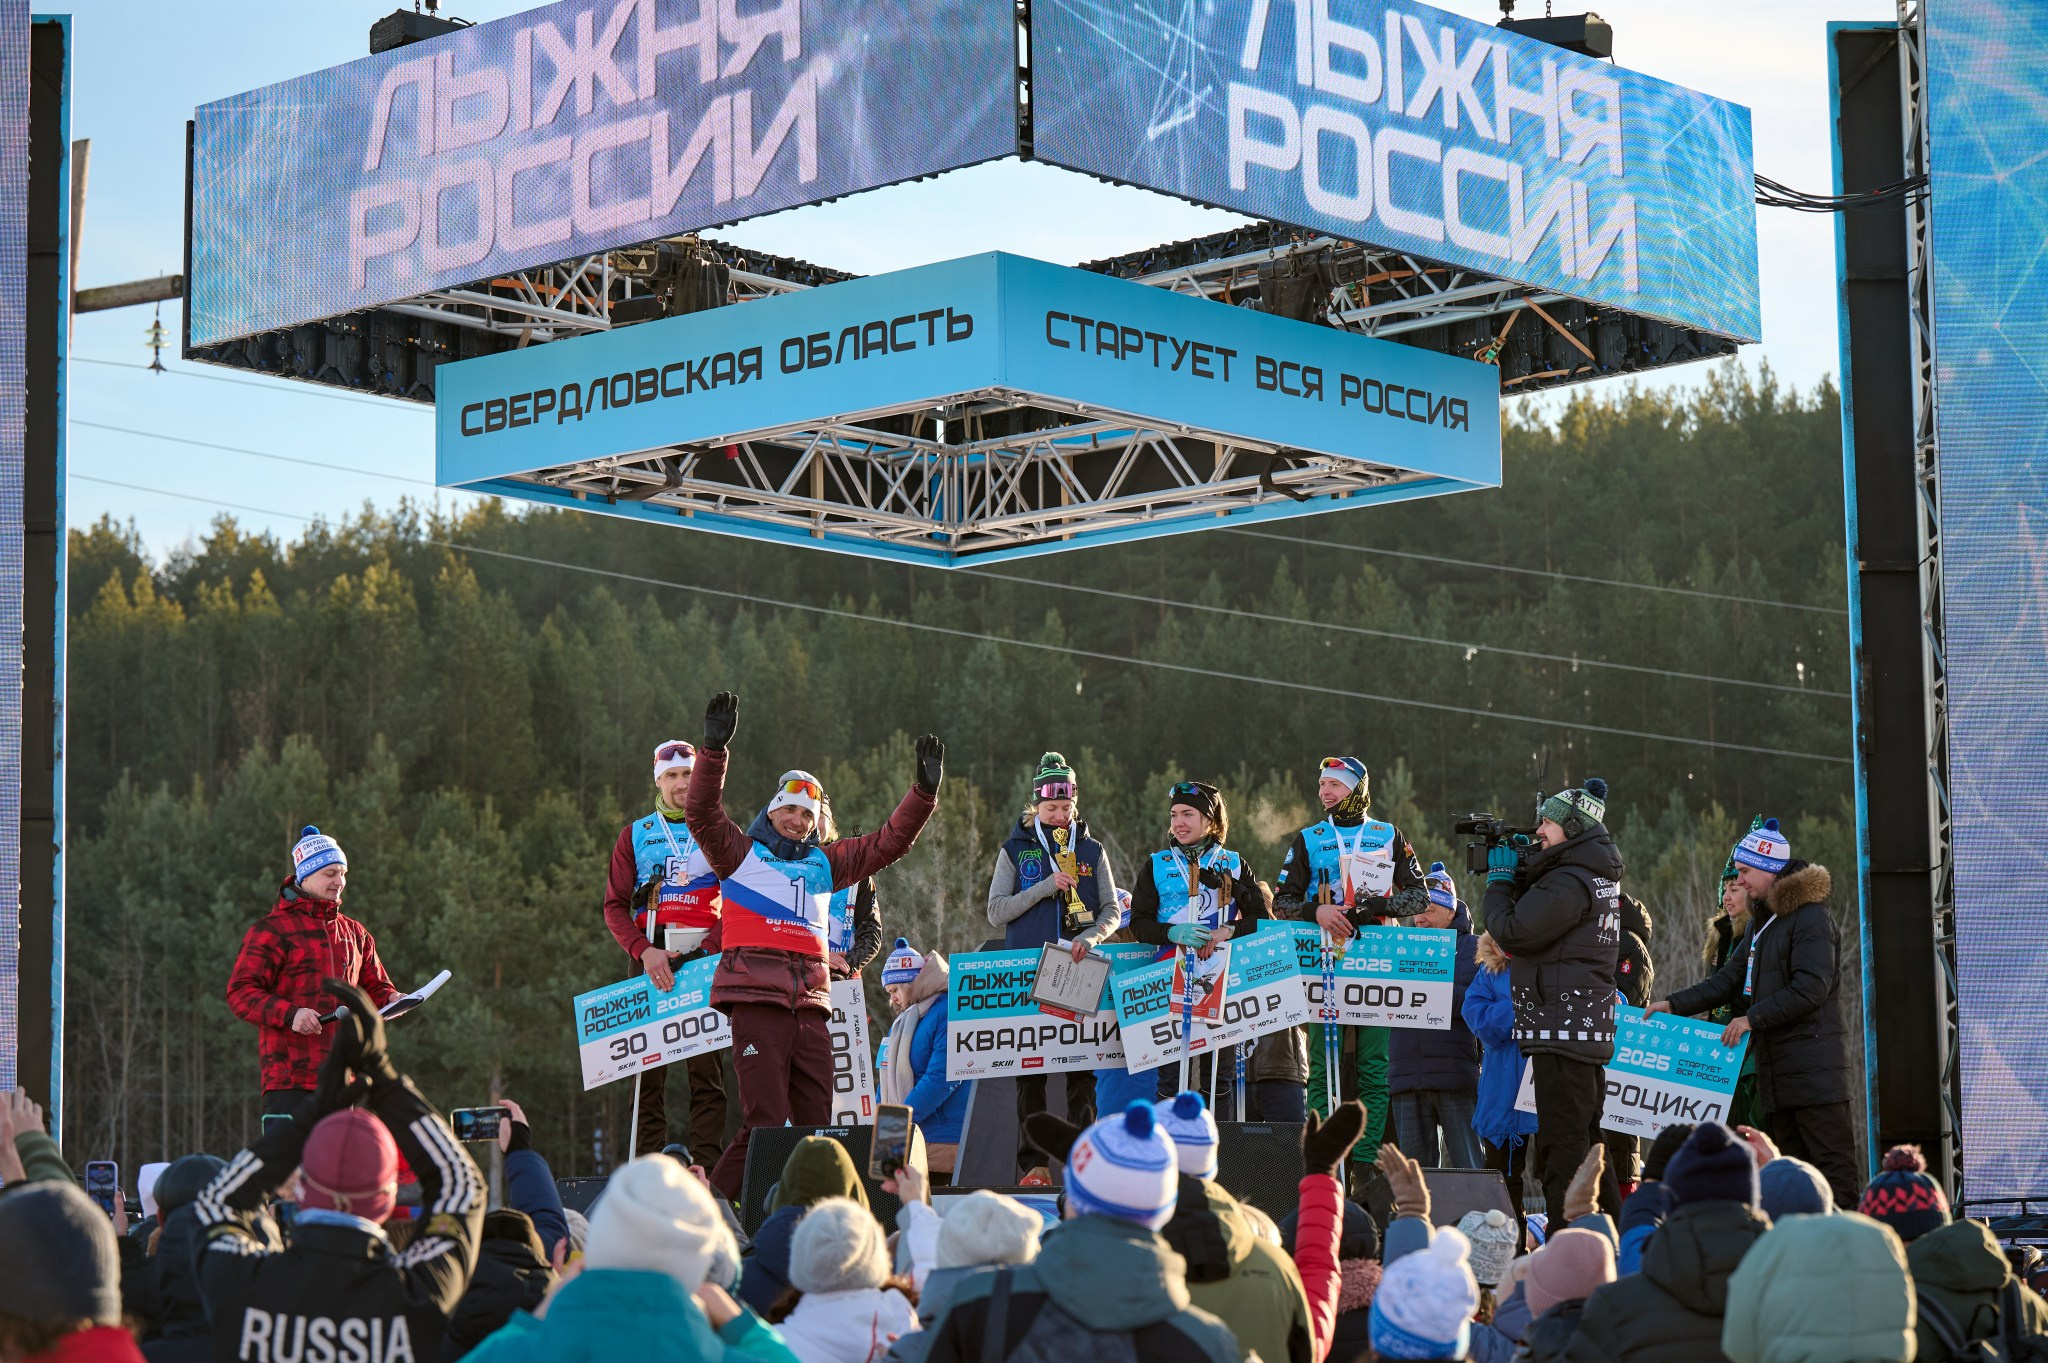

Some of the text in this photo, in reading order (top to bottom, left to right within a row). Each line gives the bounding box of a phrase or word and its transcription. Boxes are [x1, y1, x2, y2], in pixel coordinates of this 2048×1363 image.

[364, 0, 803, 173] ЛЫЖНЯ
[1242, 0, 1625, 178] ЛЫЖНЯ
[349, 68, 819, 292] РОССИИ
[1228, 82, 1640, 293] РОССИИ
[461, 307, 974, 437] СВЕРДЛОВСКАЯ ОБЛАСТЬ
[1045, 310, 1469, 432] СТАРТУЕТ ВСЯ РОССИЯ
[300, 857, 324, 874] 2025
[662, 893, 699, 905] ПОБЕДА!
[790, 875, 805, 919] 1
[1246, 931, 1287, 947] ФЕВРАЛЯ
[1408, 934, 1451, 943] ФЕВРАЛЯ
[958, 957, 1037, 971] СВЕРДЛОВСКАЯ
[1246, 959, 1283, 975] СТАРТУЕТ
[1247, 973, 1263, 983] ВСЯ
[1264, 964, 1293, 978] РОССИЯ
[1342, 957, 1393, 972] 2025
[1399, 959, 1439, 967] СТАРТУЕТ
[958, 970, 1036, 992] ЛЫЖНЯ
[582, 981, 646, 1006] СВЕРДЛОВСКАЯ
[656, 989, 704, 1014] 2025
[957, 991, 1038, 1011] РОССИИ
[1344, 984, 1404, 1007] 000
[584, 989, 649, 1022] ЛЫЖНЯ
[585, 1005, 651, 1037] РОССИИ
[1623, 1014, 1667, 1030] ОБЛАСТЬ
[610, 1011, 719, 1061] 30 000
[830, 1031, 855, 1093] 000
[1617, 1047, 1671, 1071] 2025
[1679, 1059, 1722, 1073] СТАРТУЕТ
[1676, 1068, 1730, 1085] ВСЯ РОССИЯ
[239, 1307, 416, 1363] RUSSIA
